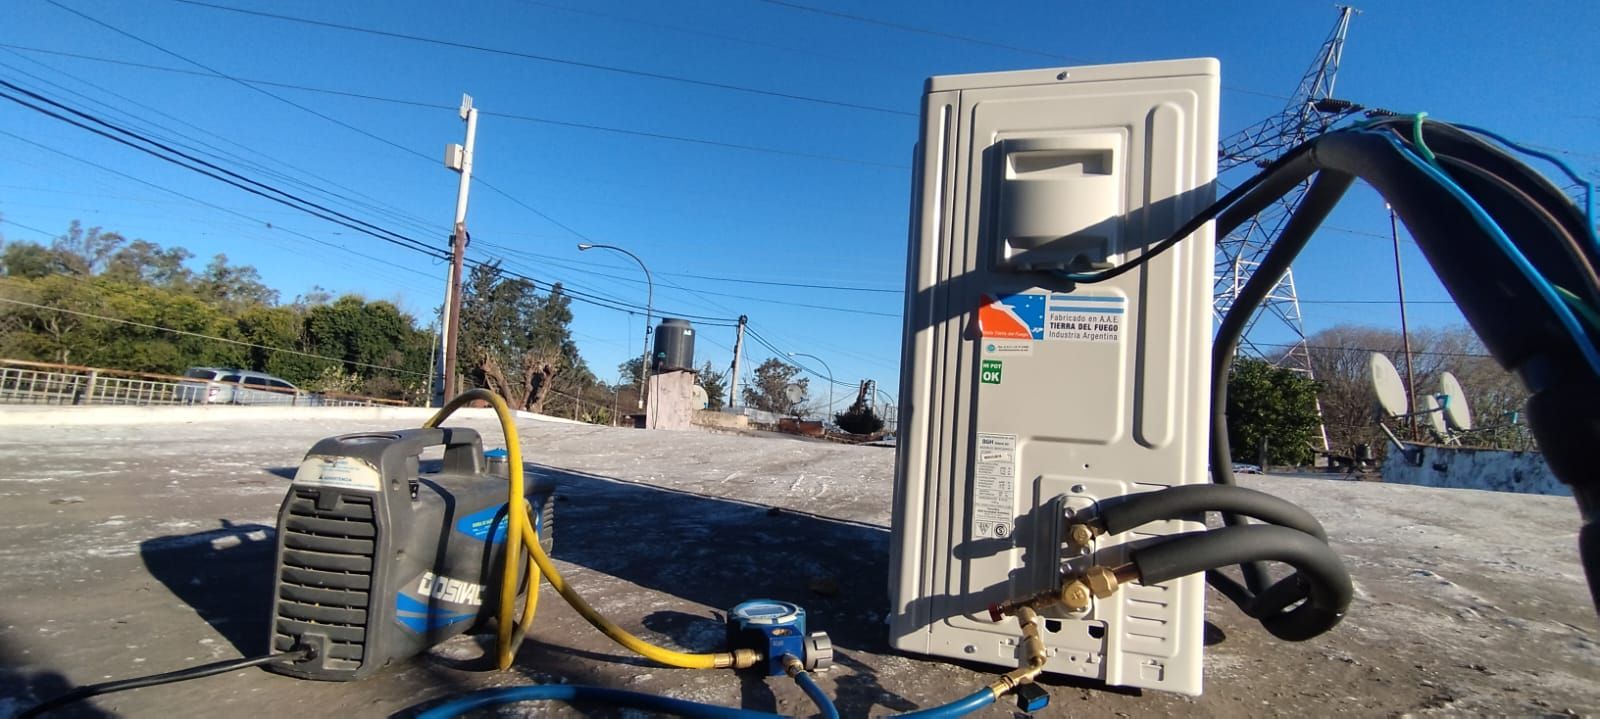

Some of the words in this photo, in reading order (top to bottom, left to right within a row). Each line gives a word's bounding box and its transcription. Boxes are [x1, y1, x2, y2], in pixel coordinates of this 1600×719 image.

[1050, 315, 1086, 323] Fabricado
[1050, 322, 1076, 330] TIERRA
[1078, 323, 1092, 331] DEL
[1094, 324, 1119, 332] FUEGO
[1049, 331, 1081, 339] Industria
[1082, 332, 1118, 341] Argentina
[983, 371, 1000, 382] OK
